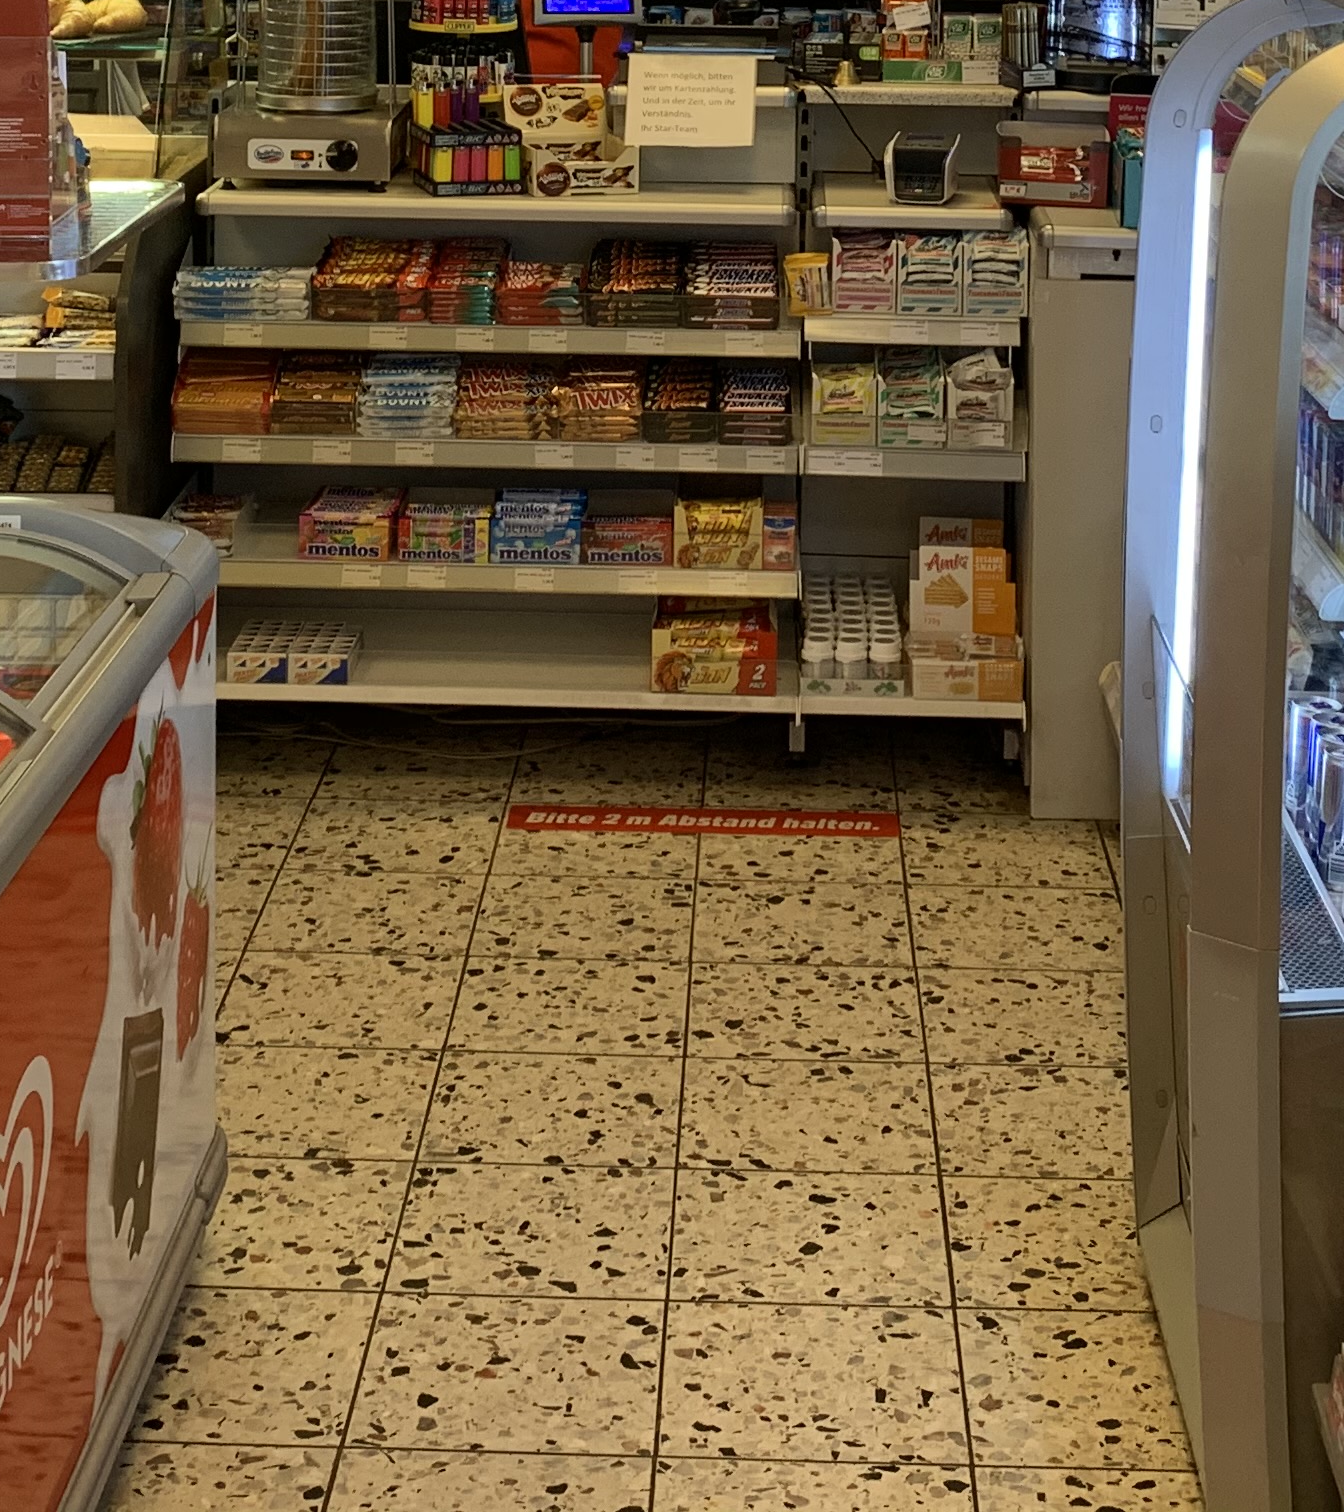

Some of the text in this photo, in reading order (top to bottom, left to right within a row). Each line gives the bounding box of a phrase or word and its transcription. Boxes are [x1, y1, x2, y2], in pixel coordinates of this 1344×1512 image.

[671, 71, 706, 81] möglich,
[708, 72, 733, 80] bitten
[643, 97, 659, 105] Und
[661, 97, 669, 105] in
[671, 97, 685, 105] der
[1119, 104, 1134, 112] Wir
[1118, 114, 1139, 122] allen
[641, 124, 698, 133] Ihr Star-Team
[570, 389, 638, 411] TWIX
[307, 541, 380, 558] mentos
[401, 547, 461, 561] mentos
[499, 545, 572, 563] mentos
[590, 548, 663, 564] mentos
[975, 563, 1004, 573] SNAPS
[753, 662, 766, 681] 2
[526, 811, 881, 831] Bitte 2 m Abstand halten.
